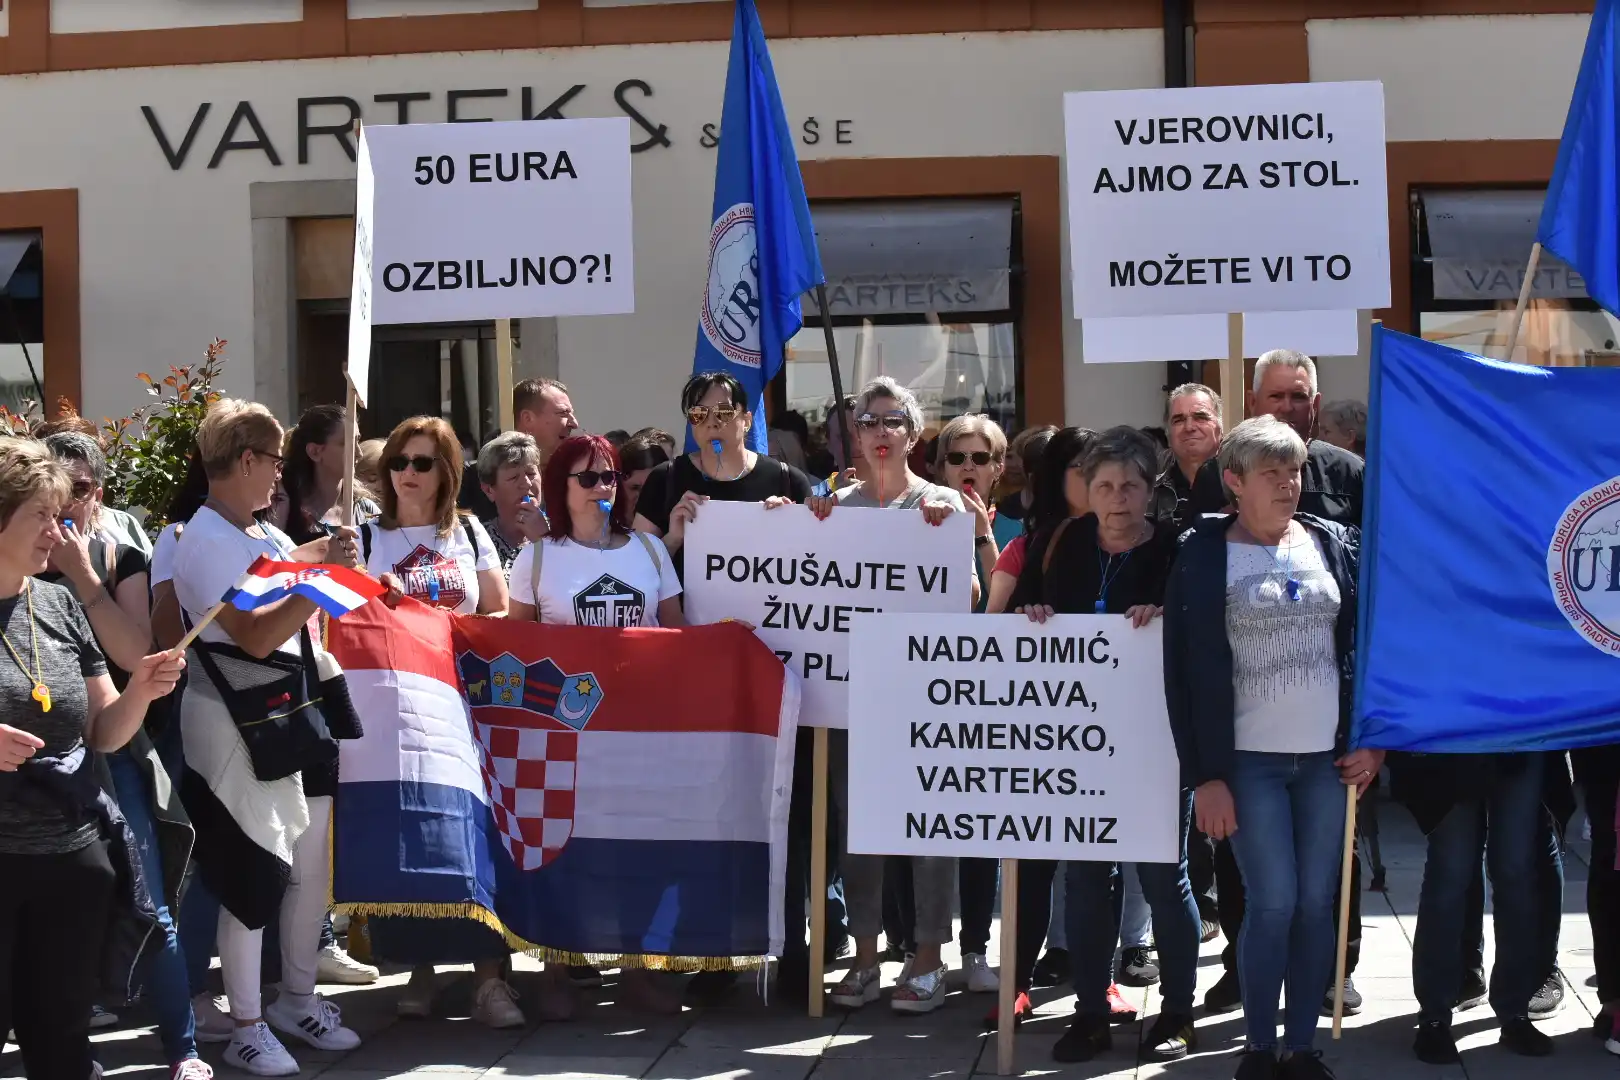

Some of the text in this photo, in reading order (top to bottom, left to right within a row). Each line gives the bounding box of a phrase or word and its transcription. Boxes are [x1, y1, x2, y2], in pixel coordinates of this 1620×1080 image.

[802, 116, 853, 145] ŠE
[1114, 112, 1333, 146] VJEROVNICI,
[414, 150, 578, 185] 50 EURA
[1093, 160, 1359, 194] AJMO ZA STOL.
[382, 253, 612, 293] OZBILJNO?!
[1109, 252, 1352, 288] MOŽETE VI TO
[1464, 268, 1586, 291] VARTE
[722, 345, 759, 364] WORKERS
[1552, 508, 1582, 553] UDRUGA
[705, 552, 948, 594] POKUŠAJTE VI
[761, 594, 883, 634] ŽIVJE
[1553, 571, 1582, 621] WORKERS
[1580, 619, 1610, 647] TRADE
[803, 652, 850, 682] PL
[908, 630, 1119, 669] NADA DIMIĆ,
[927, 678, 1097, 713] ORLJAVA,
[910, 721, 1115, 757] KAMENSKO,
[916, 765, 1105, 796] VARTEKS...
[906, 812, 1118, 844] NASTAVI NIZ
